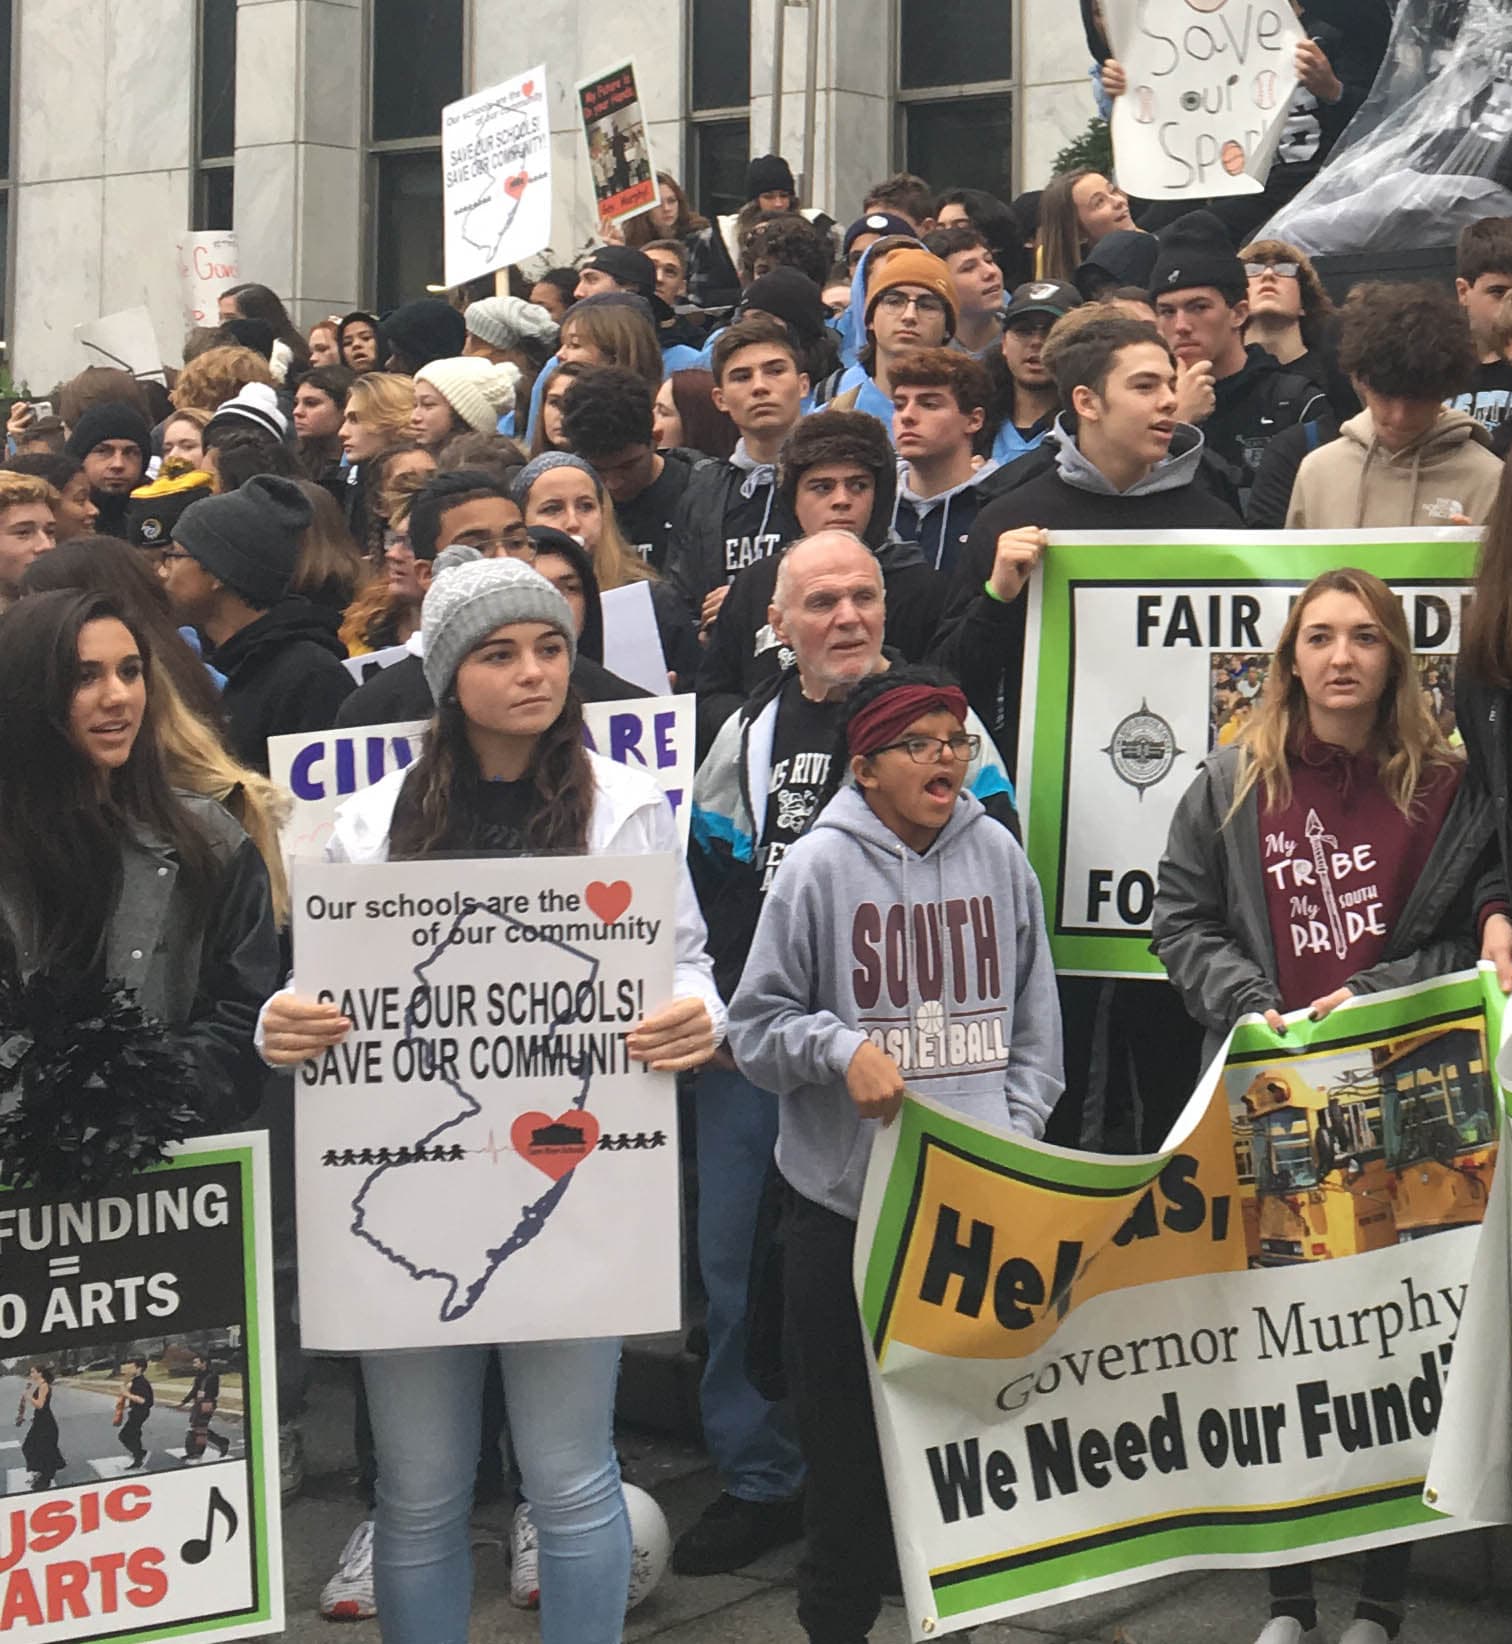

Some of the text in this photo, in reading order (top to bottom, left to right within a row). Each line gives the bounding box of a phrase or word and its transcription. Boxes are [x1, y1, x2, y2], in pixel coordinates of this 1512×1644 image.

[1137, 0, 1283, 76] Save
[1179, 74, 1239, 115] our
[446, 164, 470, 188] SAVE
[450, 142, 474, 167] SAVE
[725, 534, 781, 570] EAST
[1137, 594, 1262, 648] FAIR
[1265, 831, 1298, 858] My
[306, 889, 581, 920] Our schools are the
[1086, 869, 1154, 925] FO
[1290, 884, 1379, 920] My SOUTH
[412, 917, 661, 946] of our community
[852, 895, 1001, 1009] SOUTH
[410, 983, 478, 1029] OUR
[487, 979, 645, 1027] SCHOOLS!
[392, 1036, 461, 1081] OUR
[470, 1031, 650, 1079] COMMUNIT
[40, 1272, 181, 1334] ARTS
[995, 1326, 1240, 1412] Governor
[1252, 1277, 1471, 1360] Murphy
[925, 1437, 1018, 1524] We
[1024, 1392, 1186, 1502] Need
[1199, 1402, 1287, 1469] our
[0, 1546, 168, 1632] ARTS
